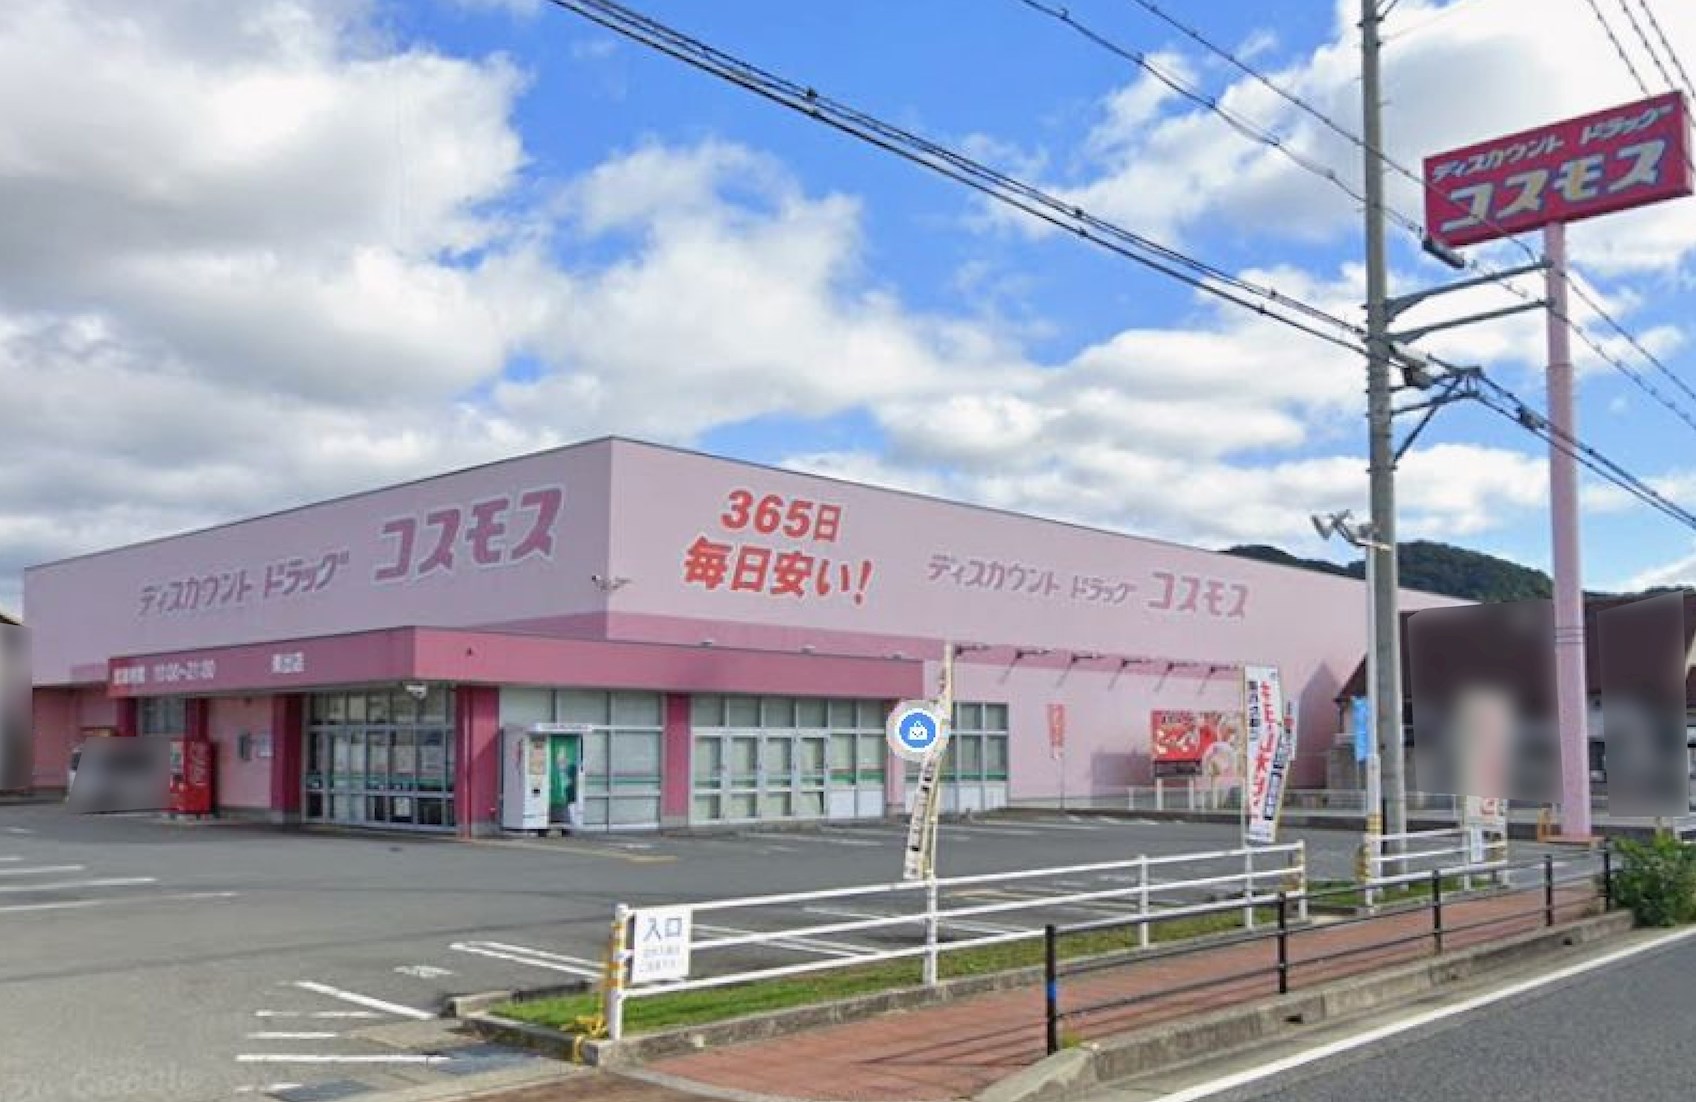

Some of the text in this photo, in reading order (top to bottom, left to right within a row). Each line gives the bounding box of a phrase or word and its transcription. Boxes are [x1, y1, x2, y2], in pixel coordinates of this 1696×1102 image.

[1432, 134, 1564, 183] ディスカウント
[1440, 139, 1666, 232] コスモス
[720, 489, 842, 542] 365日
[140, 487, 563, 616] ディスカウント ドラッグ コスモス
[684, 535, 873, 605] 毎日安い!
[927, 554, 1249, 618] ディスカウント ドラッグ コスモス
[642, 916, 683, 942] 入口
